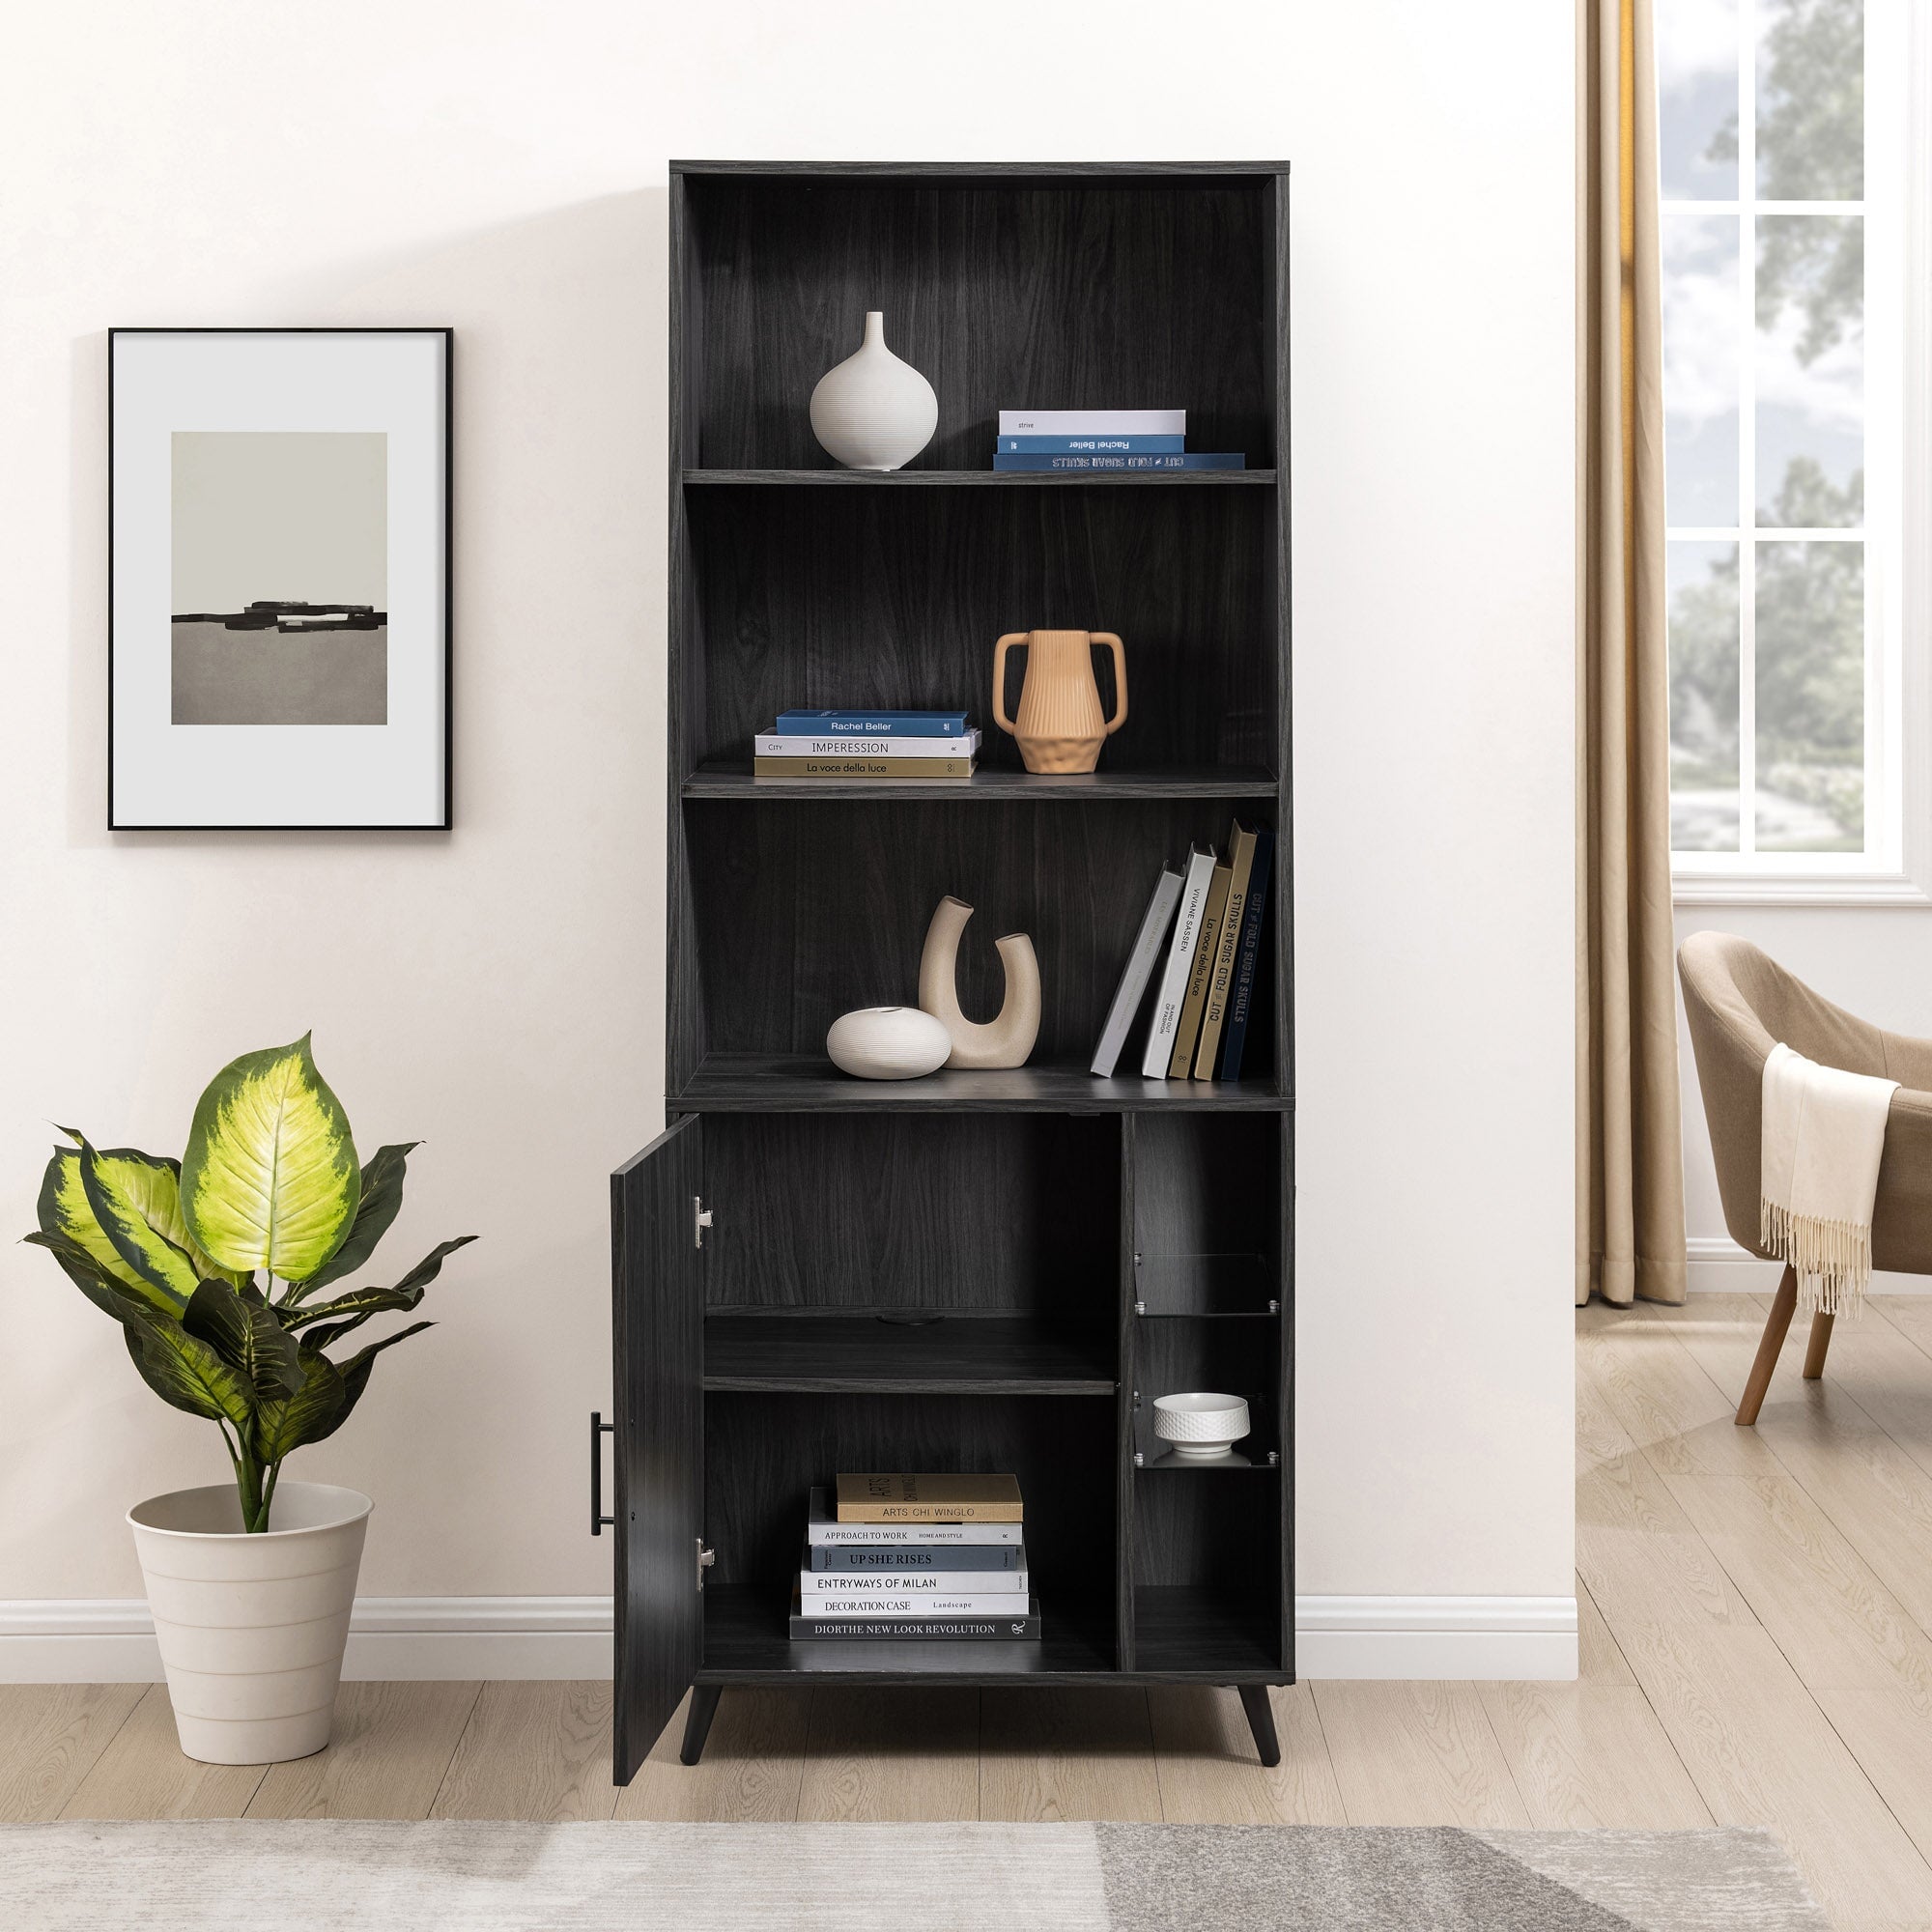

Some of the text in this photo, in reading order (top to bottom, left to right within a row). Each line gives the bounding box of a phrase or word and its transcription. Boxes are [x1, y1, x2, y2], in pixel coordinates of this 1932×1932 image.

[1052, 457, 1090, 468] SKULLS
[1092, 457, 1124, 468] SUGAR
[831, 722, 892, 730] Rachel Beller
[811, 742, 889, 753] IMPERESSION
[807, 762, 887, 773] La voce della luce
[1180, 888, 1201, 952] VIVIANE SASSEN
[1192, 919, 1216, 997] La voce della luce
[1209, 894, 1243, 1021] CUT FOLD SUGAR SKULLS
[1234, 894, 1263, 1023] CUT FOLD SUGAR SKULLS
[868, 1477, 891, 1497] ARTS
[882, 1508, 975, 1517] ARTS CHI WINGLO
[825, 1531, 907, 1540] APPROACH TO WORK
[850, 1554, 932, 1565] UP SHE RISES
[817, 1578, 937, 1588] ENTRYWAYS OF MILAN
[825, 1601, 911, 1610] DECORATION CASE
[814, 1625, 996, 1634] DIORTHE NEW LOOK REVOLUTION
